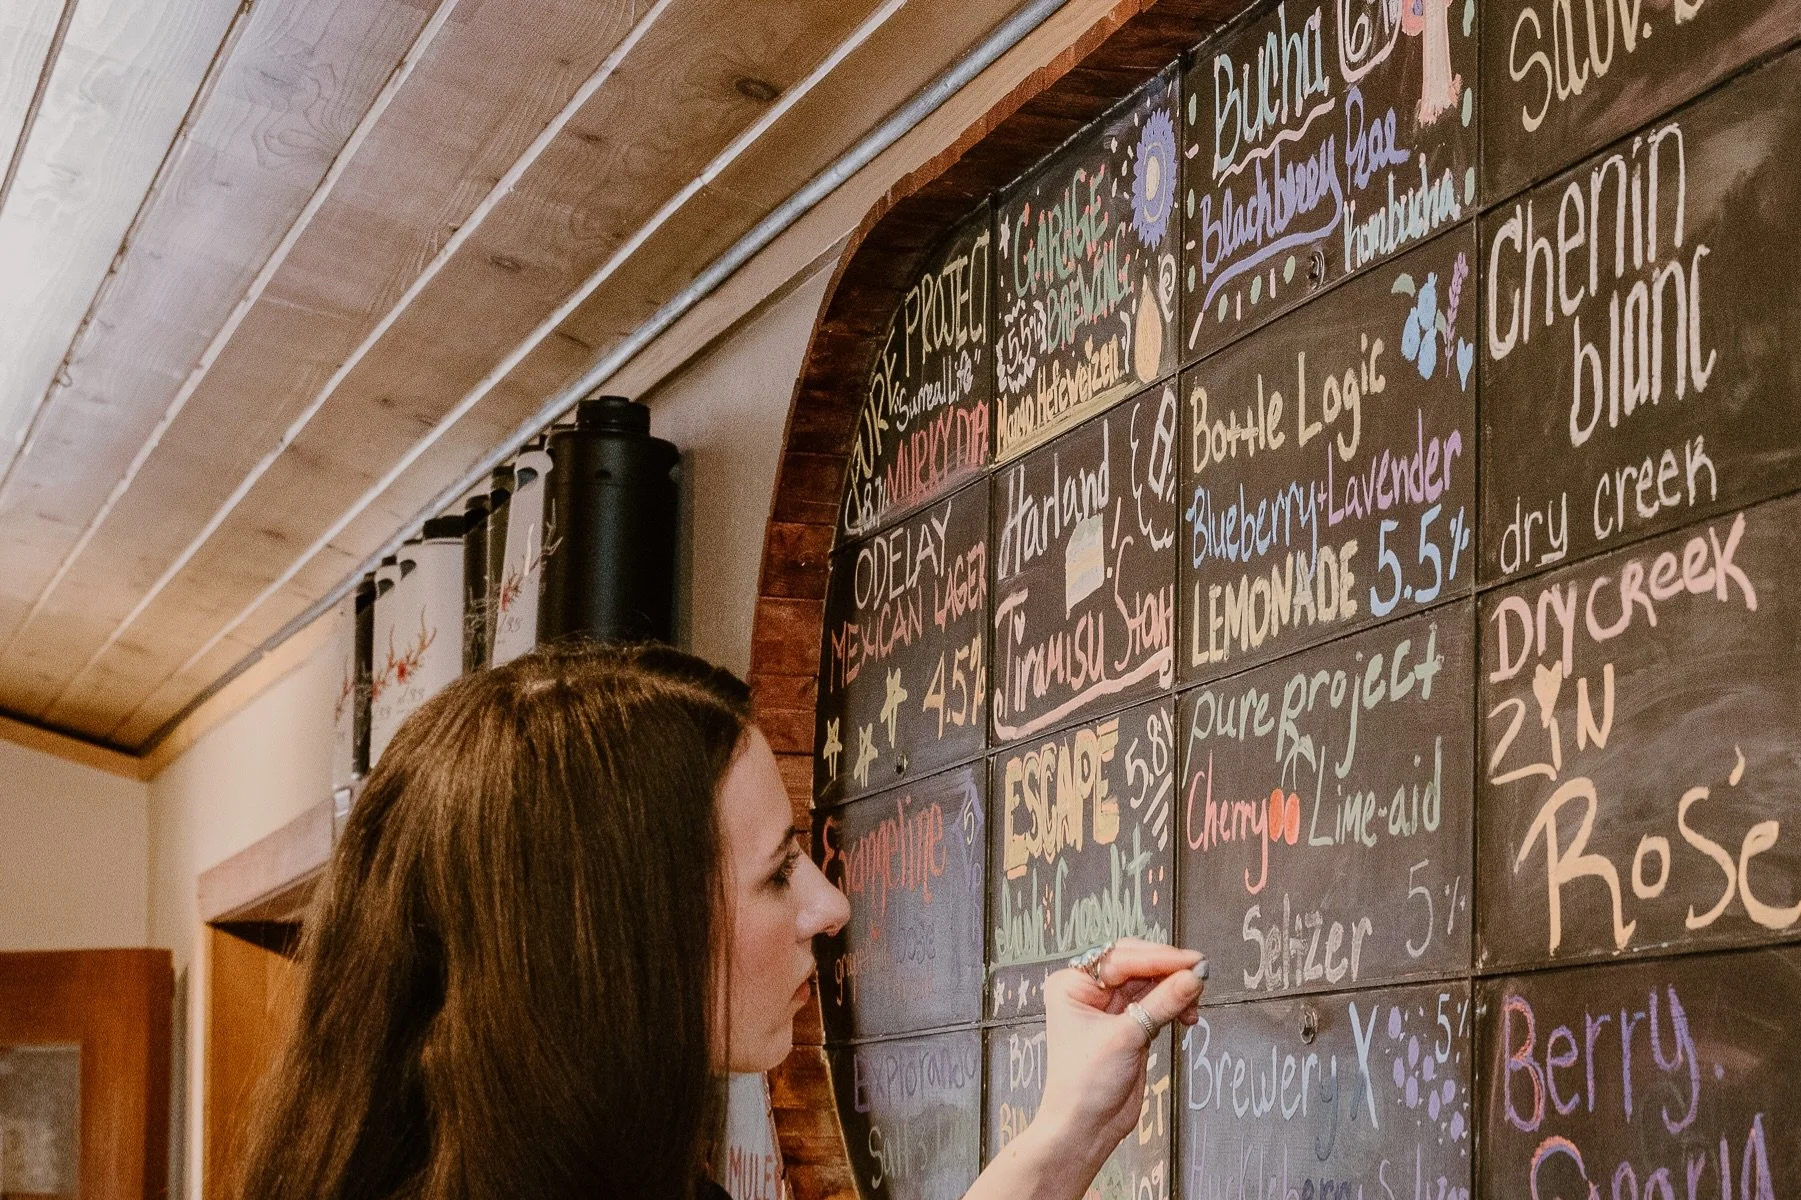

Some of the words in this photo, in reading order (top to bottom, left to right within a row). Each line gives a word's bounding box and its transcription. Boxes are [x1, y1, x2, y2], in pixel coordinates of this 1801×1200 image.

[1213, 1, 1329, 180] Bucha
[1014, 163, 1109, 298] GARAGE
[1200, 134, 1343, 284] Blackberry
[1489, 122, 1685, 360] Chenin
[905, 229, 989, 378] PROJECT
[1570, 243, 1717, 448] blanc
[1190, 374, 1286, 474] Bottle
[1298, 332, 1386, 462] Logic
[855, 499, 952, 611] ODELAY
[998, 418, 1110, 581] Harland
[1500, 496, 1568, 575] dry
[1593, 434, 1717, 541] creek
[831, 585, 923, 694] MEXICAN
[933, 540, 987, 634] LAGER
[1192, 539, 1359, 667] LEMONADE
[1369, 503, 1471, 618] 5.5%
[1181, 688, 1275, 789] pure
[1276, 621, 1445, 780] project
[1002, 716, 1120, 880] ESCAPE
[1186, 749, 1269, 895] Cherry
[1182, 1015, 1339, 1162] Brewery
[1348, 1000, 1380, 1131] X
[1503, 983, 1701, 1134] Berry
